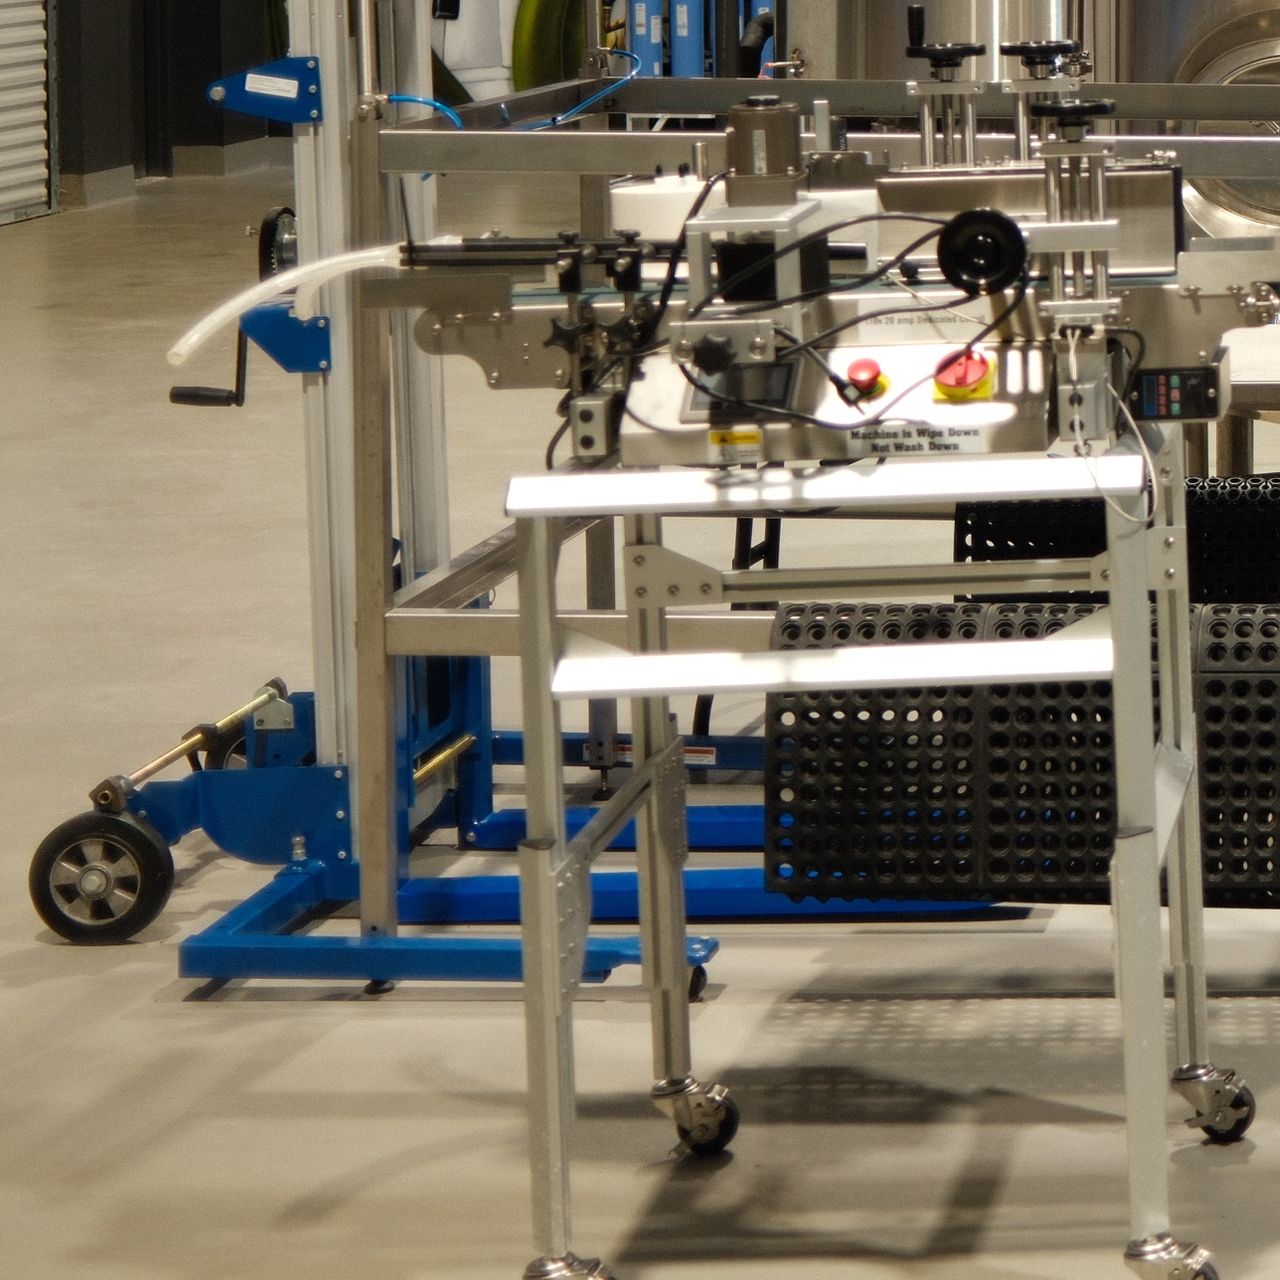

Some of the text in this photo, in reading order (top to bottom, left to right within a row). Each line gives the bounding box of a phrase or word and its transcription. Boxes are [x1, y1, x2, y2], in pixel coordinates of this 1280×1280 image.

[851, 427, 979, 440] Machine is Wipe Down
[871, 441, 959, 452] Not Wash Down
